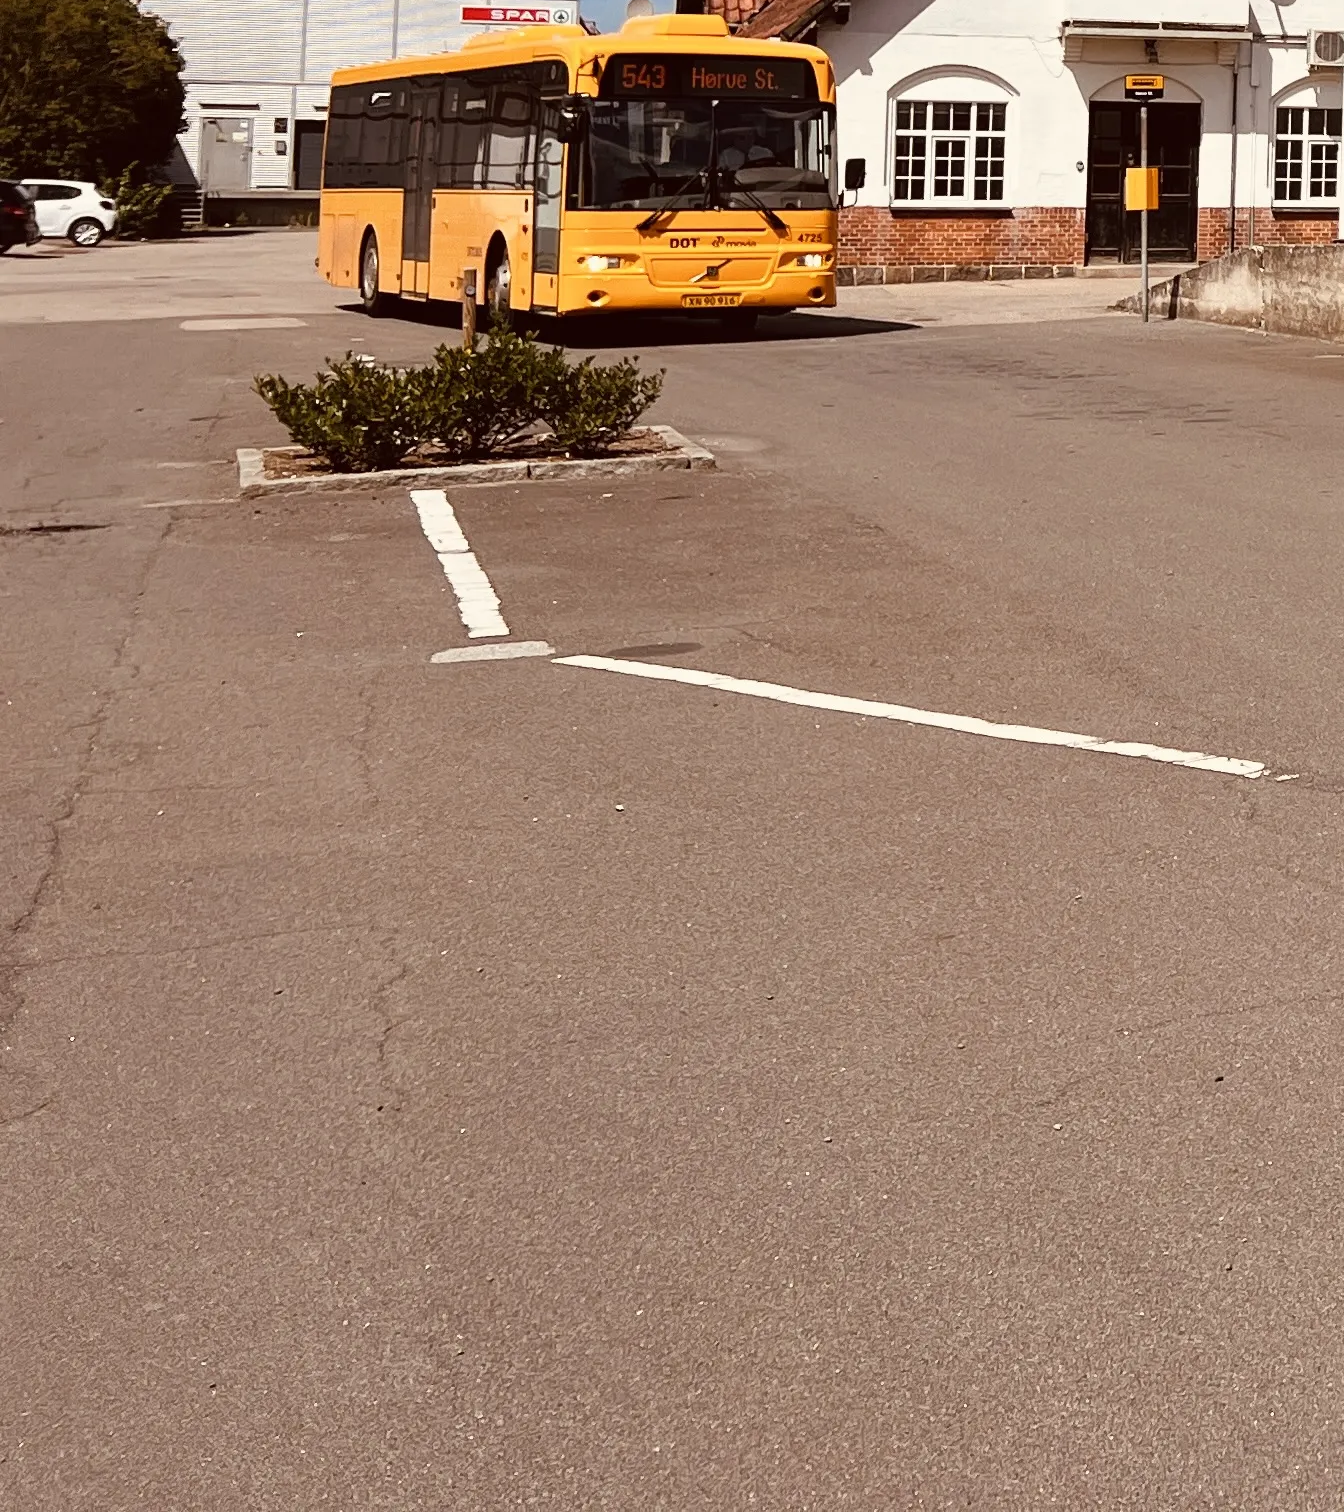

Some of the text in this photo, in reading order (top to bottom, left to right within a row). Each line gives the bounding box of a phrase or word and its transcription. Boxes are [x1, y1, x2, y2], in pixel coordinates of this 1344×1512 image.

[490, 9, 549, 22] SPAR
[622, 64, 779, 90] 543 Hørve St.
[670, 238, 699, 248] DOT
[797, 233, 823, 243] 4725
[717, 297, 735, 306] 916
